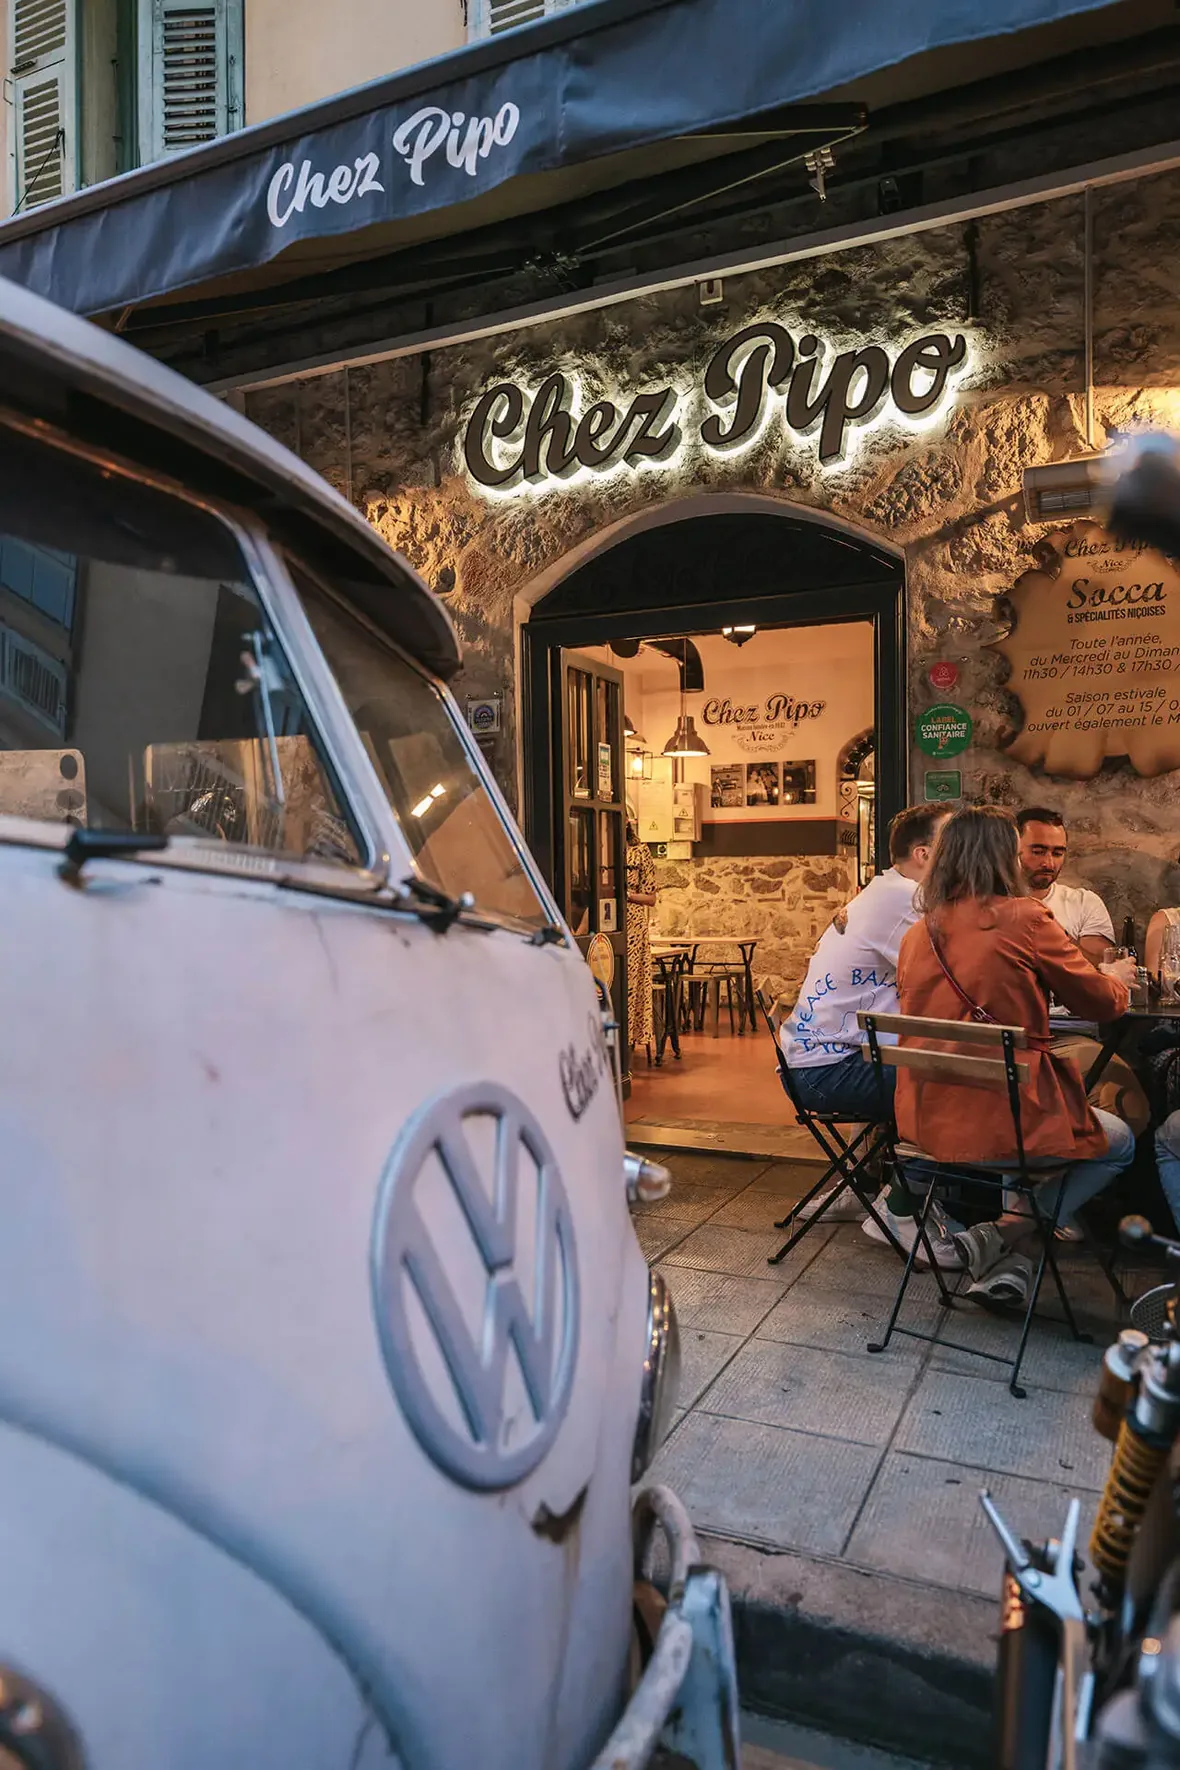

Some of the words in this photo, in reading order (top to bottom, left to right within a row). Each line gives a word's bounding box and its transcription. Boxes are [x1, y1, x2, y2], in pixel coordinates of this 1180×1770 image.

[266, 152, 385, 228] Chez
[392, 101, 520, 186] Pipo
[465, 373, 681, 486] Chez
[701, 322, 966, 466] Pipo
[1064, 538, 1111, 558] Chez
[1066, 578, 1167, 610] Socca
[1067, 613, 1074, 624] &
[1075, 608, 1126, 624] SPÉCIALITÉS
[1127, 605, 1166, 620] NIÇOISES
[1070, 638, 1107, 650] Toute
[1030, 656, 1047, 667] du
[1050, 650, 1110, 665] Mercredi
[1113, 651, 1130, 660] au
[1023, 667, 1058, 680] 11h30
[1072, 663, 1113, 677] 14h30
[1116, 662, 1126, 673] &
[1131, 659, 1172, 672] 17h30
[1065, 691, 1110, 704] Saison
[1114, 687, 1167, 701] estivale
[702, 697, 759, 725] Chez
[766, 693, 826, 728] Pipo
[1046, 706, 1062, 717] du
[1067, 705, 1082, 717] 01
[1096, 703, 1114, 715] 07
[1118, 704, 1134, 714] au
[1140, 701, 1153, 712] 15
[921, 723, 967, 732] CONFIANCE
[930, 716, 956, 724] LABEL
[1027, 719, 1070, 732] ouvert
[1074, 715, 1147, 731] également
[1151, 714, 1163, 725] le
[746, 731, 774, 741] Nice
[922, 730, 966, 739] SANITAIRE
[796, 972, 838, 1033] PEACE
